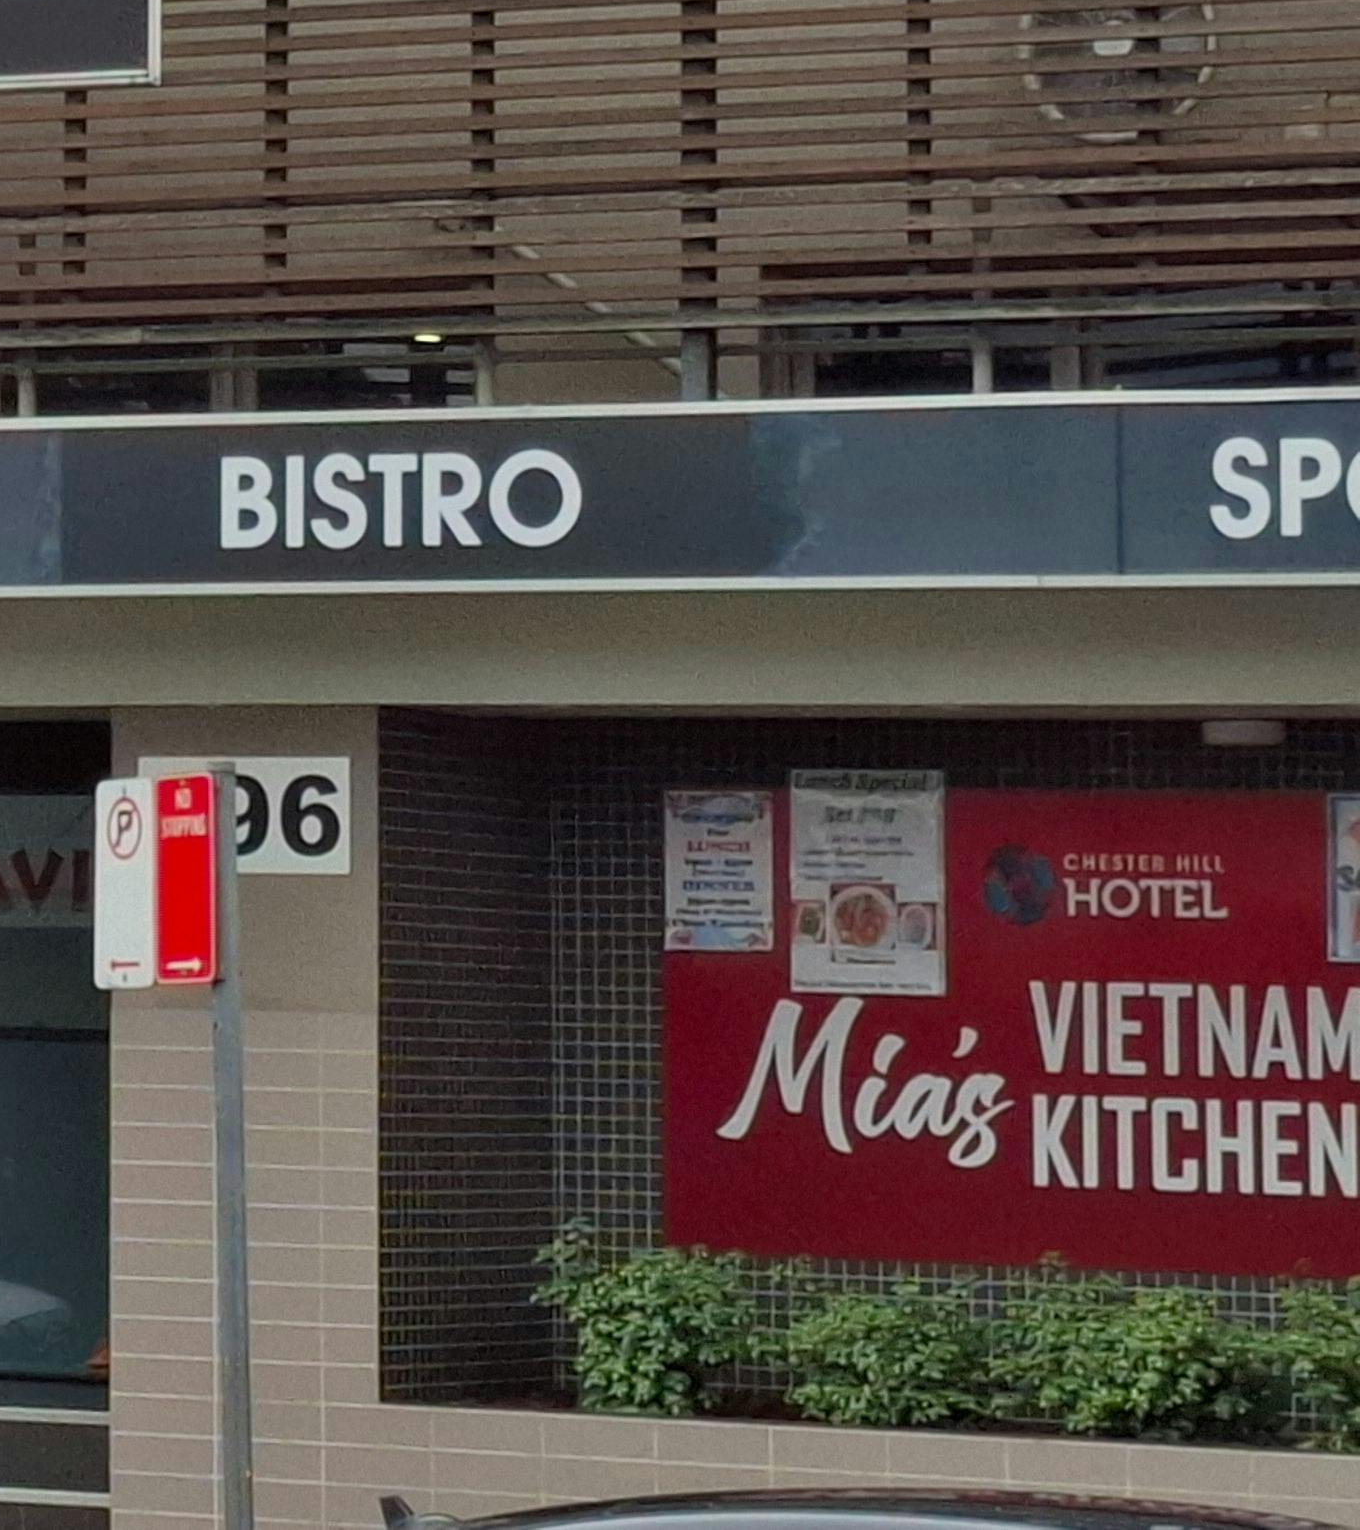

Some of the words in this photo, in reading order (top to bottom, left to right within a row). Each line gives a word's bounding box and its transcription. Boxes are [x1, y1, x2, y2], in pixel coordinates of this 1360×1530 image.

[221, 449, 582, 549] BISTRO
[1209, 436, 1360, 540] SP
[173, 787, 192, 810] NO
[1062, 878, 1229, 918] HOTEL
[1063, 853, 1165, 872] CHESTER
[1176, 854, 1225, 873] HILL
[1029, 981, 1360, 1082] VIETNAM
[716, 998, 1014, 1169] Mia's
[1033, 1094, 1359, 1198] KITCHEN
